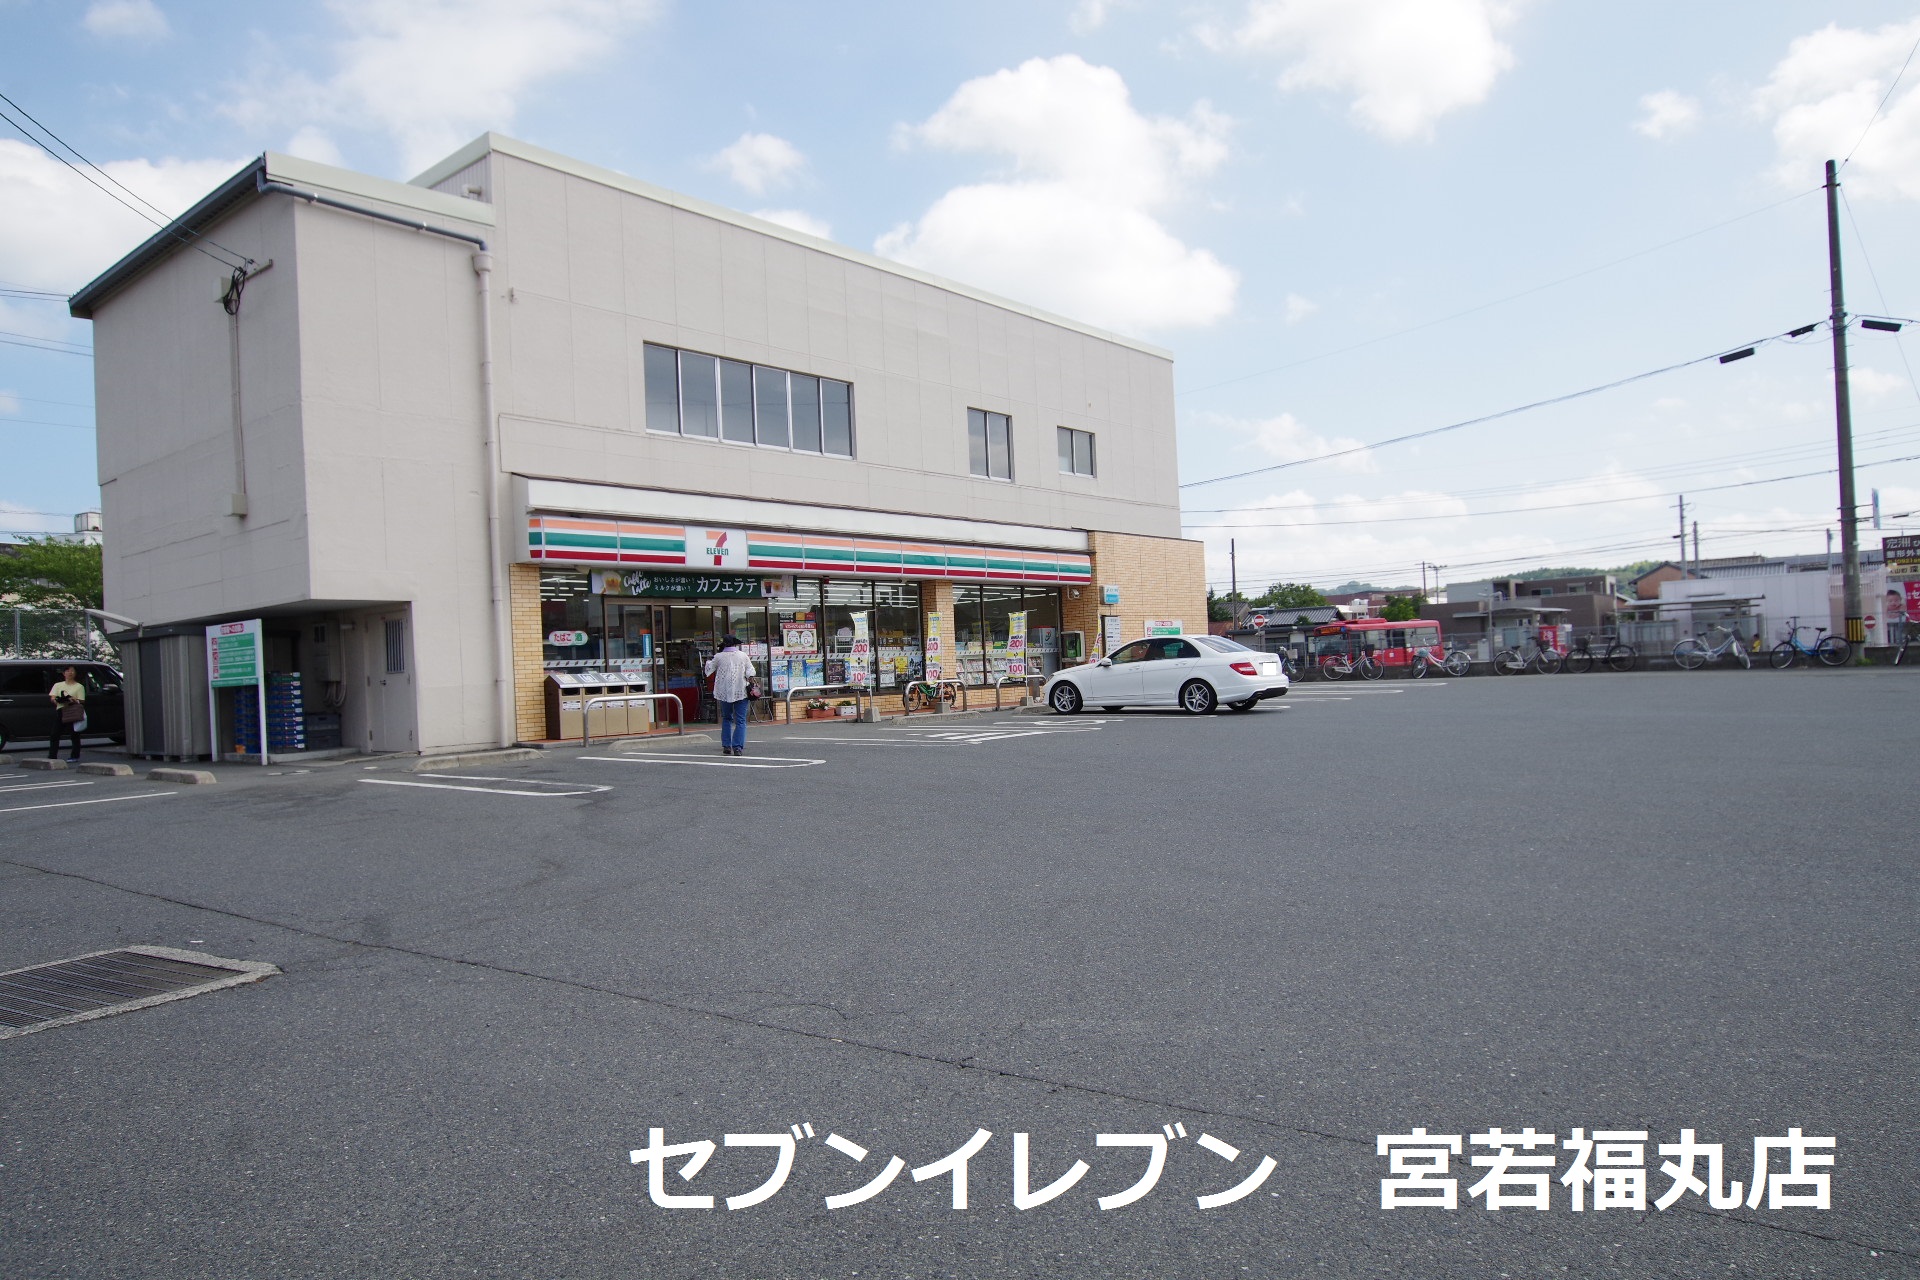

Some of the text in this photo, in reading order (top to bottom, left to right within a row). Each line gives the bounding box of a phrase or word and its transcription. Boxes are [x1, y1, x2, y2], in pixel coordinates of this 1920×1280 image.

[697, 576, 758, 594] カフェラテ
[553, 633, 571, 641] たばこ
[852, 643, 868, 653] 200
[927, 642, 938, 651] 200
[1010, 640, 1022, 648] 200
[1009, 664, 1022, 673] 100
